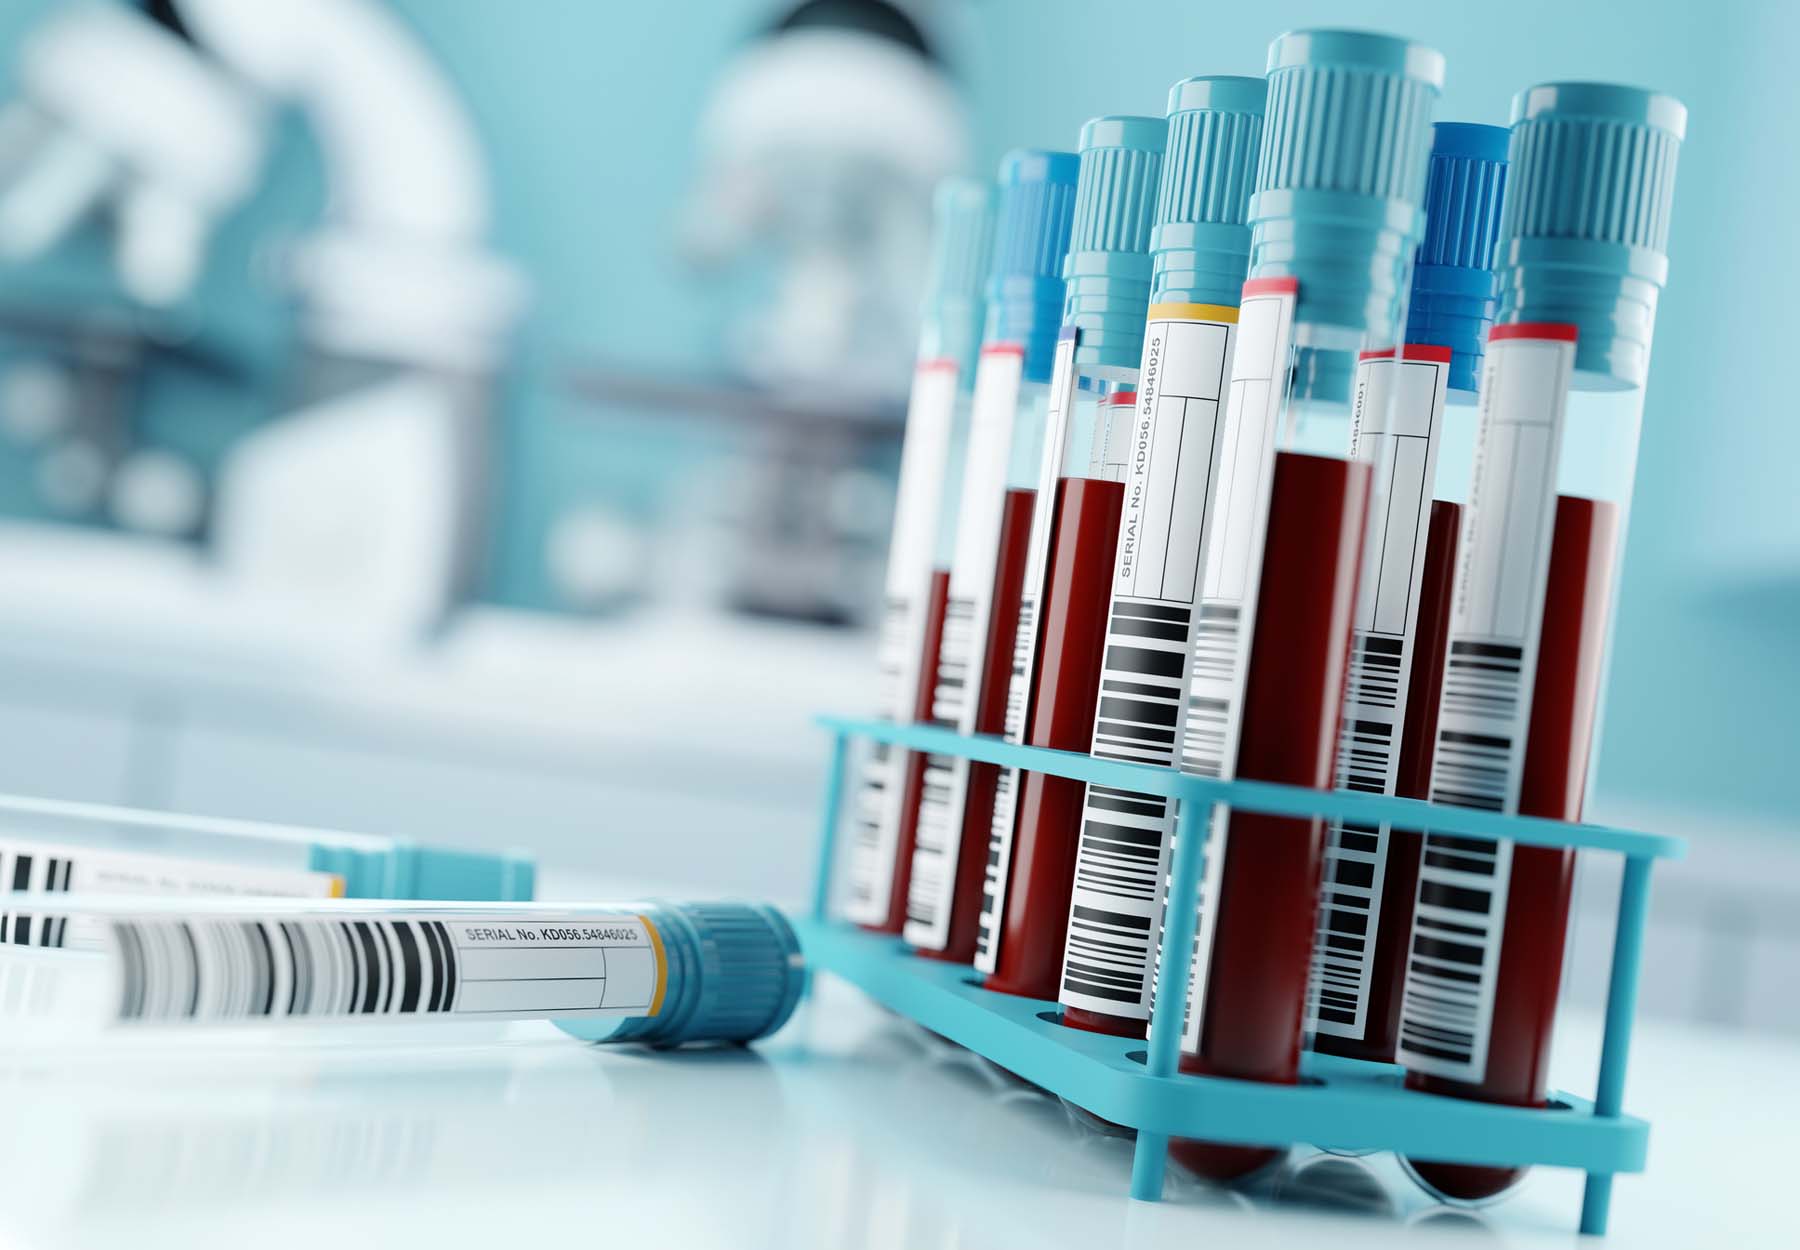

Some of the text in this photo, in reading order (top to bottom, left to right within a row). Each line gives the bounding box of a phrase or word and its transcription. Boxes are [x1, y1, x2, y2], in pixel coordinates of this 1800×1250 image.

[1121, 337, 1161, 578] SERIAL No. KD056.54846025
[465, 928, 638, 941] SERIAL No. KD056.54846025
